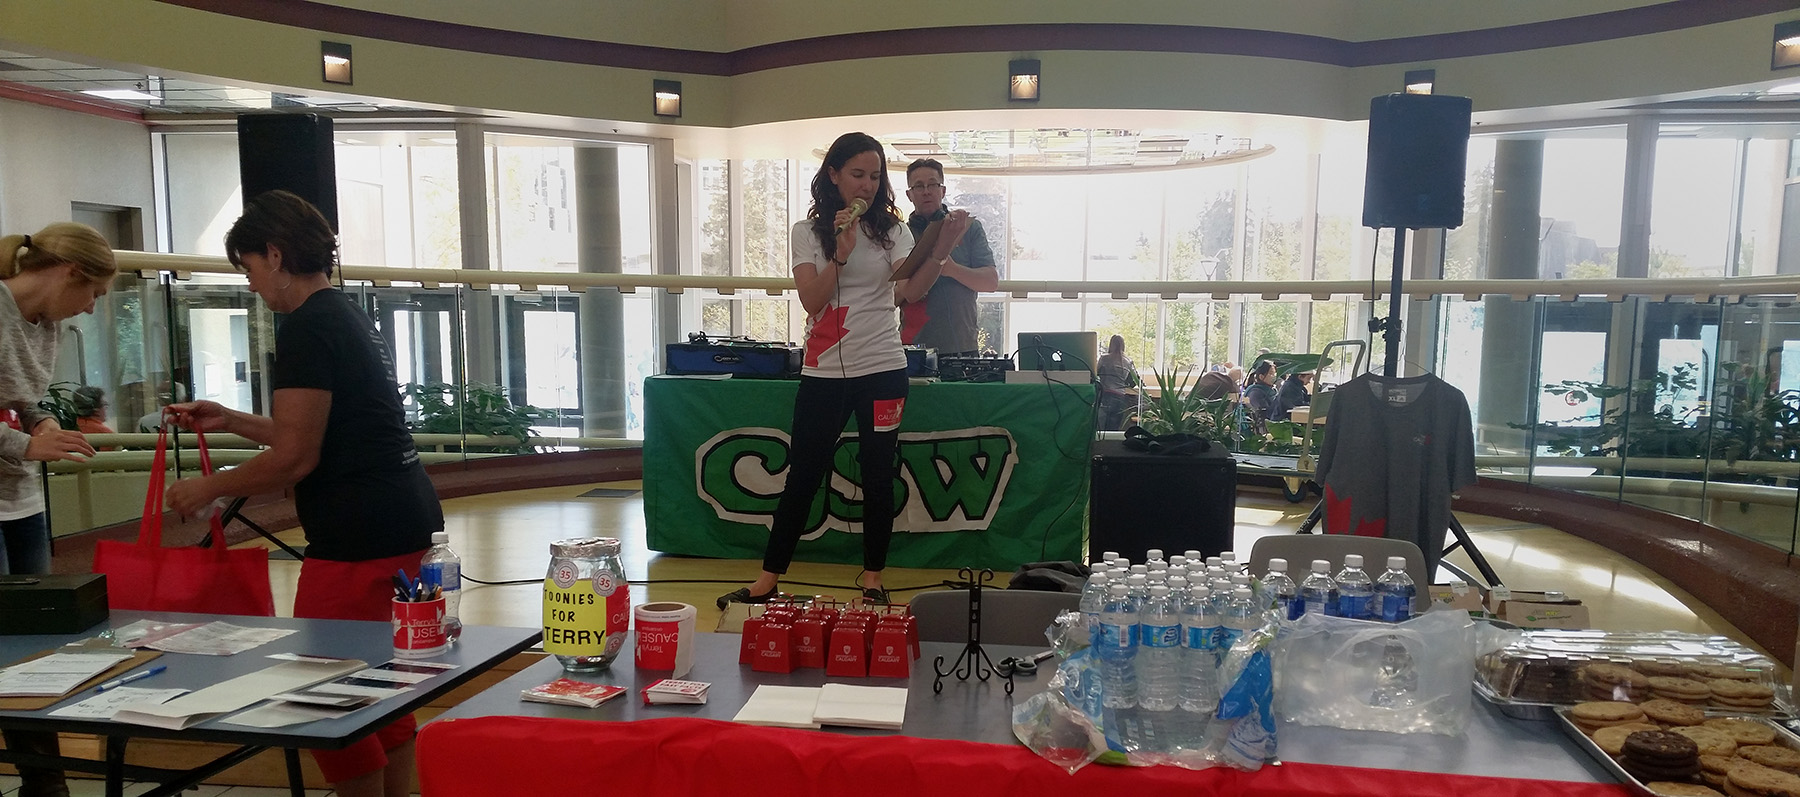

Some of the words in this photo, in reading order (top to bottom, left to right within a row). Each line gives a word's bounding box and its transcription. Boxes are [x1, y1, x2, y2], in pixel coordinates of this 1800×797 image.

[560, 571, 571, 580] 35
[599, 578, 611, 588] 35
[544, 589, 594, 605] TOONIES
[552, 608, 576, 622] FOR
[412, 627, 436, 639] USE
[544, 626, 606, 645] TERRY
[642, 632, 679, 643] CAUSE
